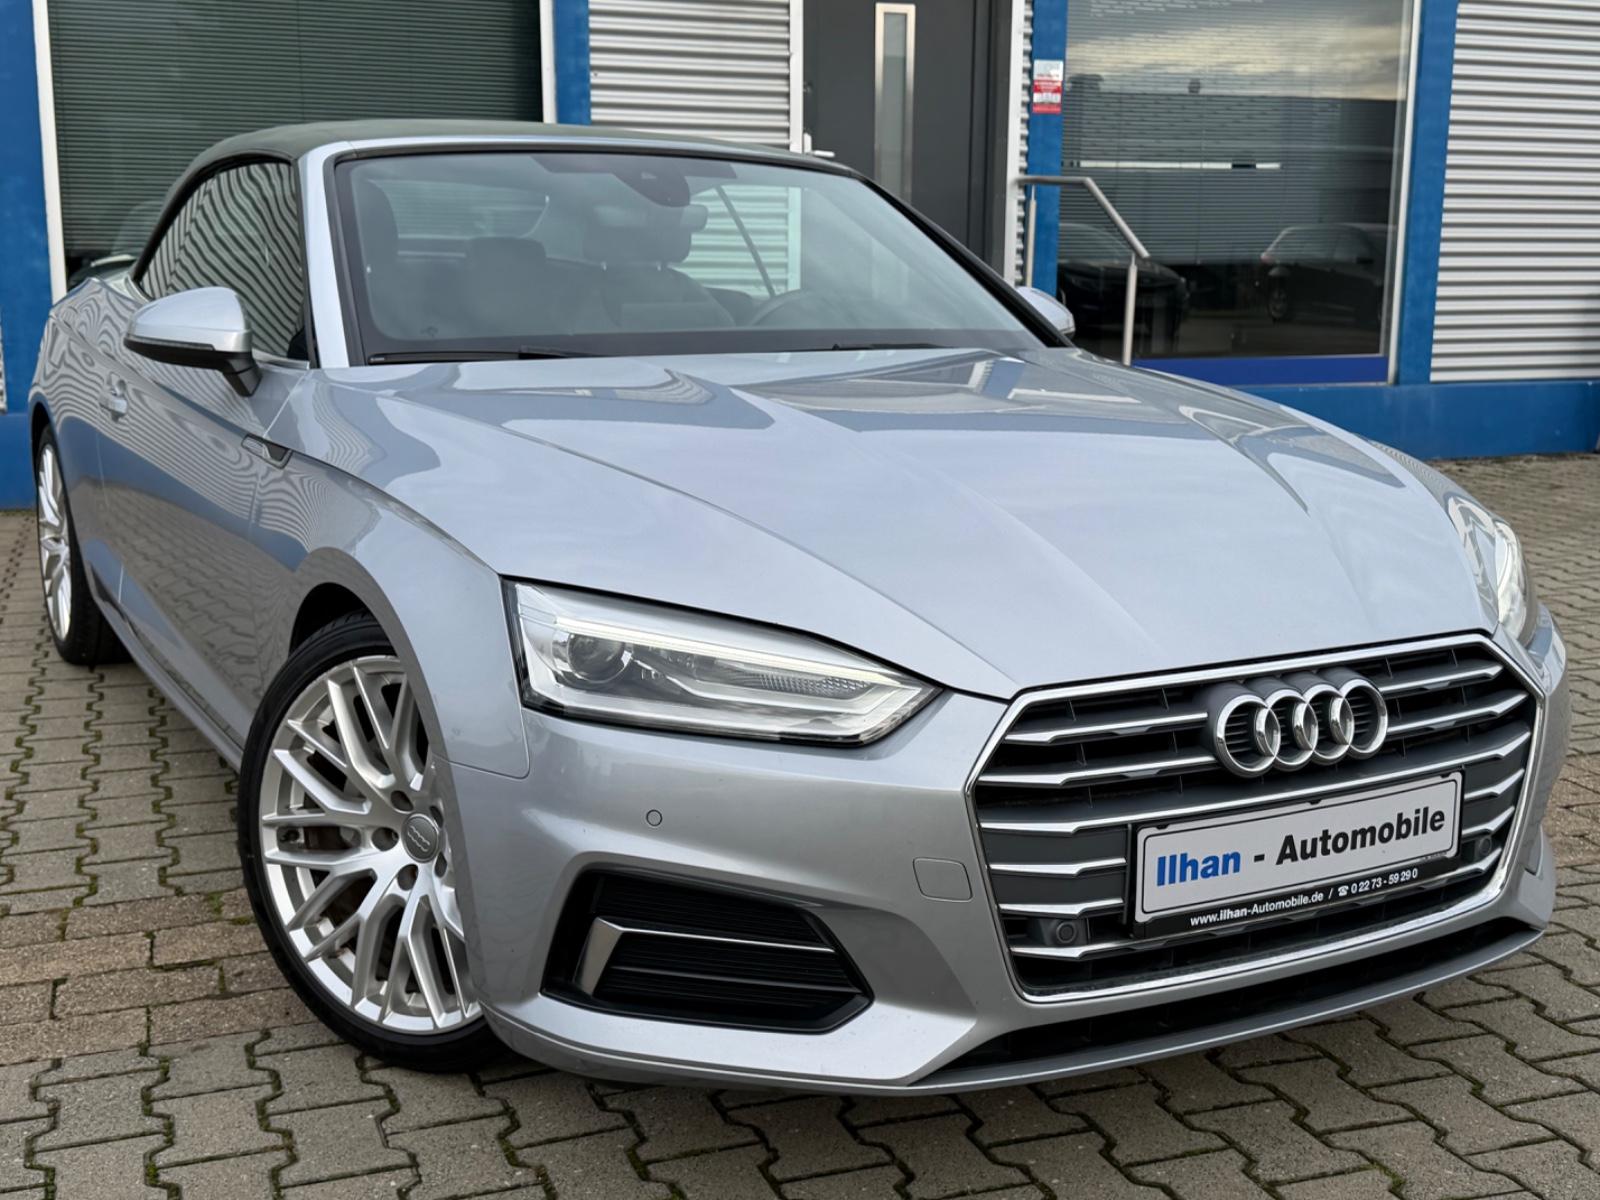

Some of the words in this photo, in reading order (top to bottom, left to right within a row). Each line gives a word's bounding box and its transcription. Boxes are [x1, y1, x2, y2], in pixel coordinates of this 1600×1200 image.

[1156, 850, 1241, 887] Ilhan
[1275, 806, 1446, 866] Automobile
[1190, 891, 1324, 926] www.ilhan-Automobile.de
